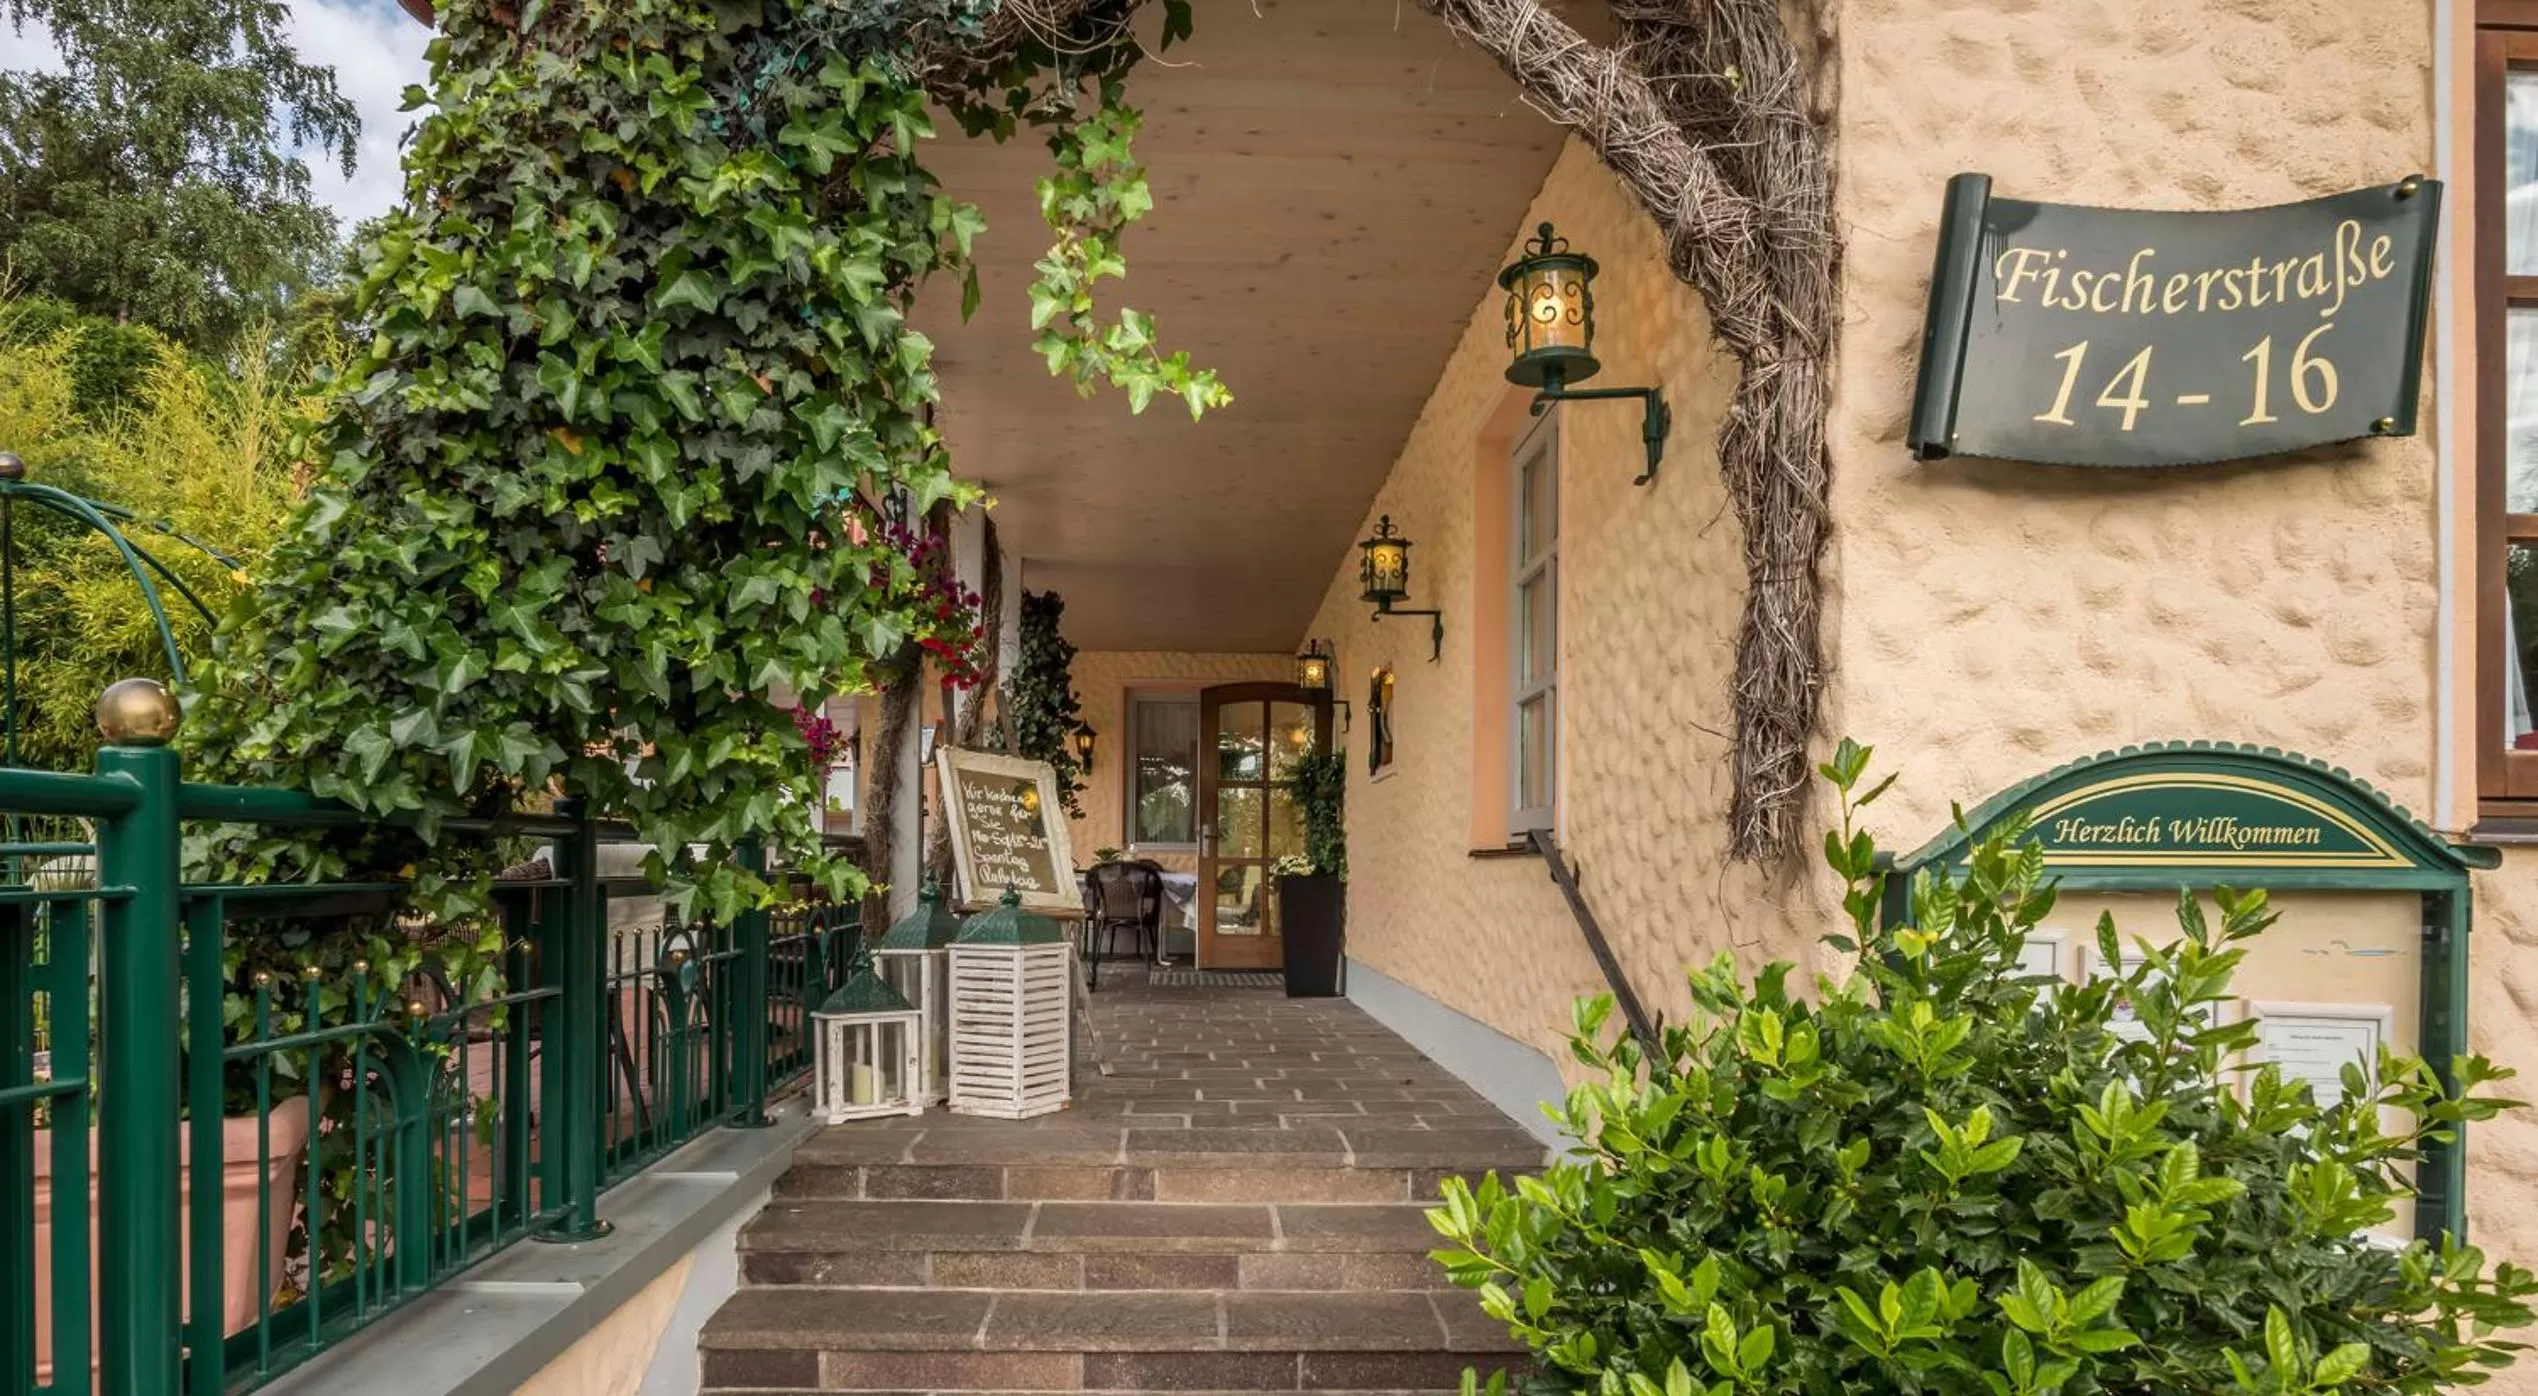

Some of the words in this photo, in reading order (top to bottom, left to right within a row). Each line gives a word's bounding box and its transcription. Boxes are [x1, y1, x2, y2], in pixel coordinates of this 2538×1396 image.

[1994, 219, 2396, 317] Fischerstraße
[2033, 338, 2154, 432] 14
[2236, 322, 2339, 427] 16
[962, 781, 983, 799] Wir
[2052, 815, 2161, 844] Herzlich
[2168, 816, 2321, 850] Willkommen
